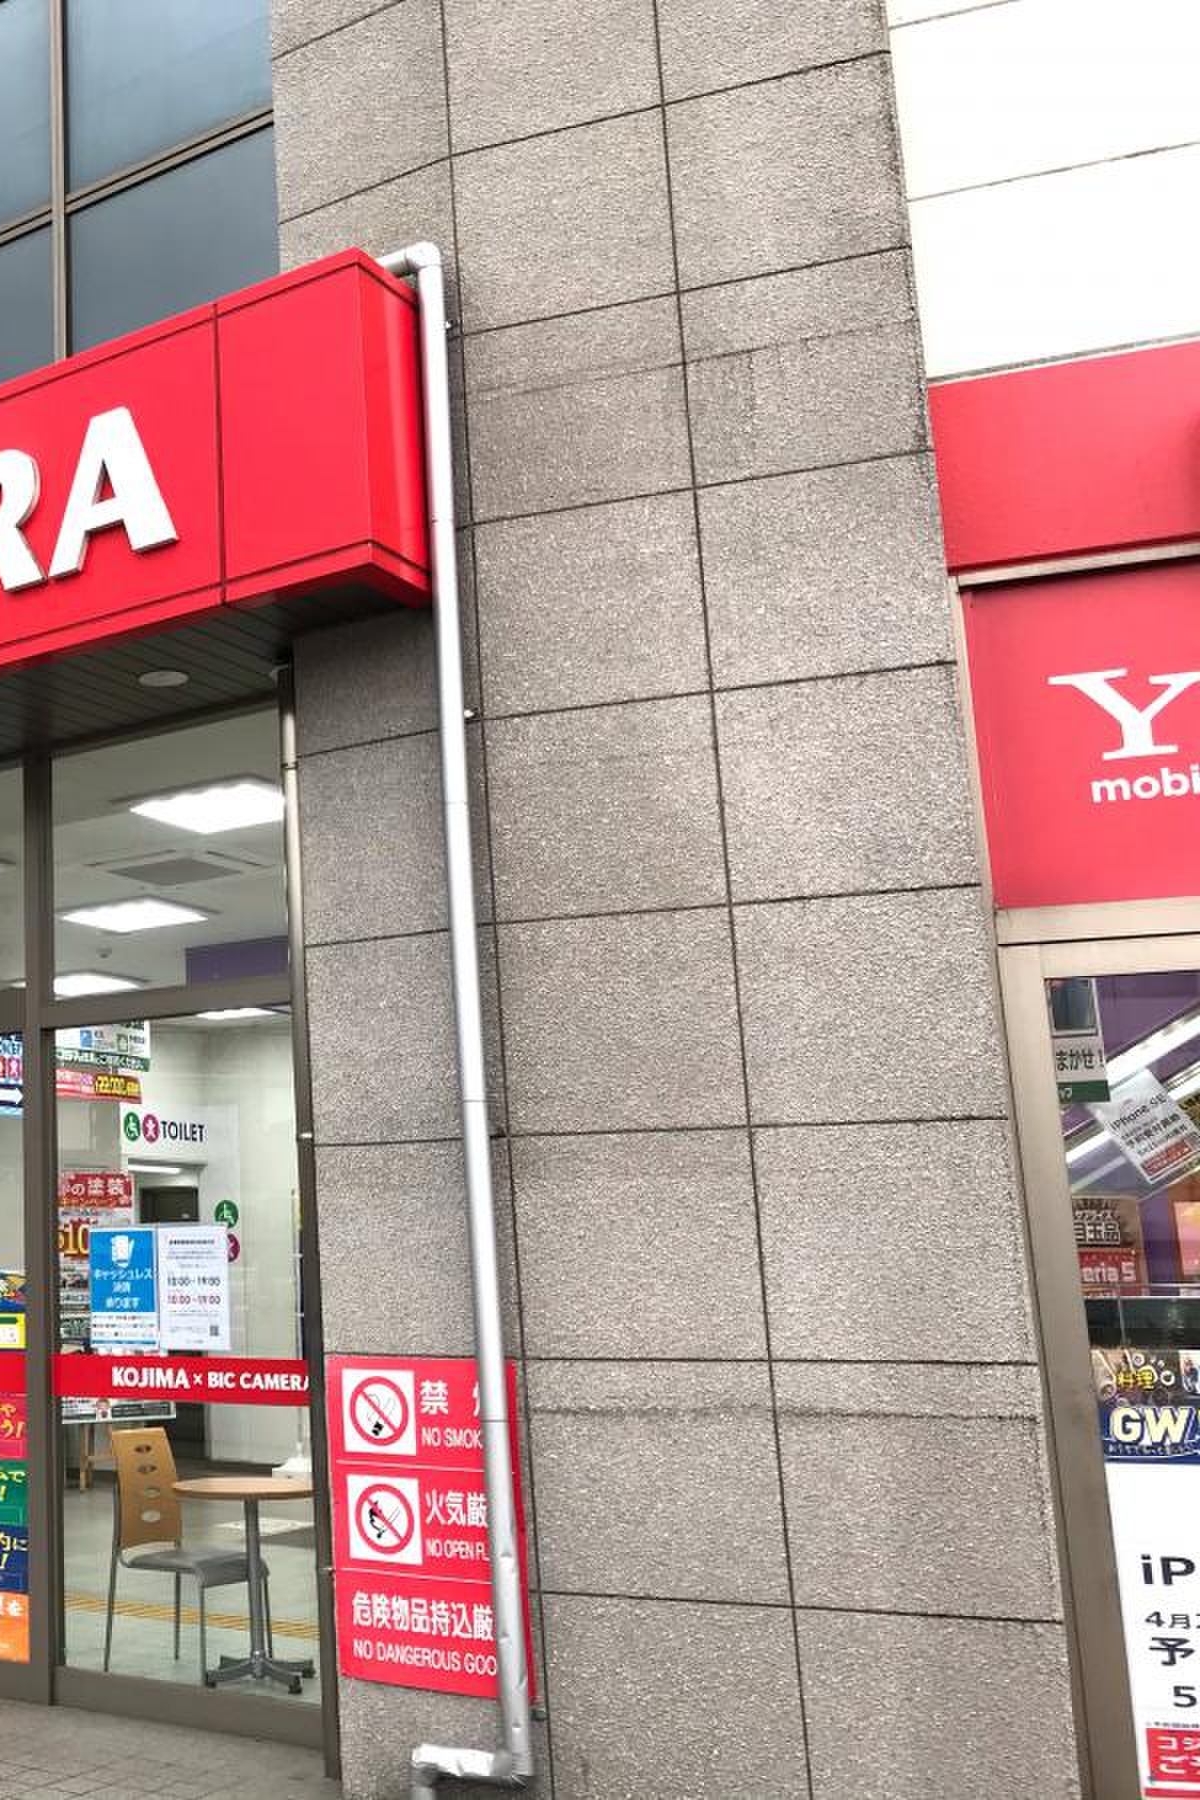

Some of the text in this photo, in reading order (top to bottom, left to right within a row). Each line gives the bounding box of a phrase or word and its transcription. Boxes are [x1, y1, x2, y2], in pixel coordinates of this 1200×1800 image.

[160, 1119, 208, 1143] TOILET
[94, 1267, 154, 1281] キャッシュレス
[111, 1366, 190, 1389] KOJIMA
[207, 1371, 236, 1388] BIC
[1110, 1405, 1189, 1444] GW
[422, 1426, 441, 1447] NO
[427, 1539, 443, 1557] NO
[444, 1540, 474, 1561] OPEN
[1141, 1554, 1196, 1586] iP
[353, 1639, 373, 1659] NO
[376, 1642, 461, 1672] DANGEROUS
